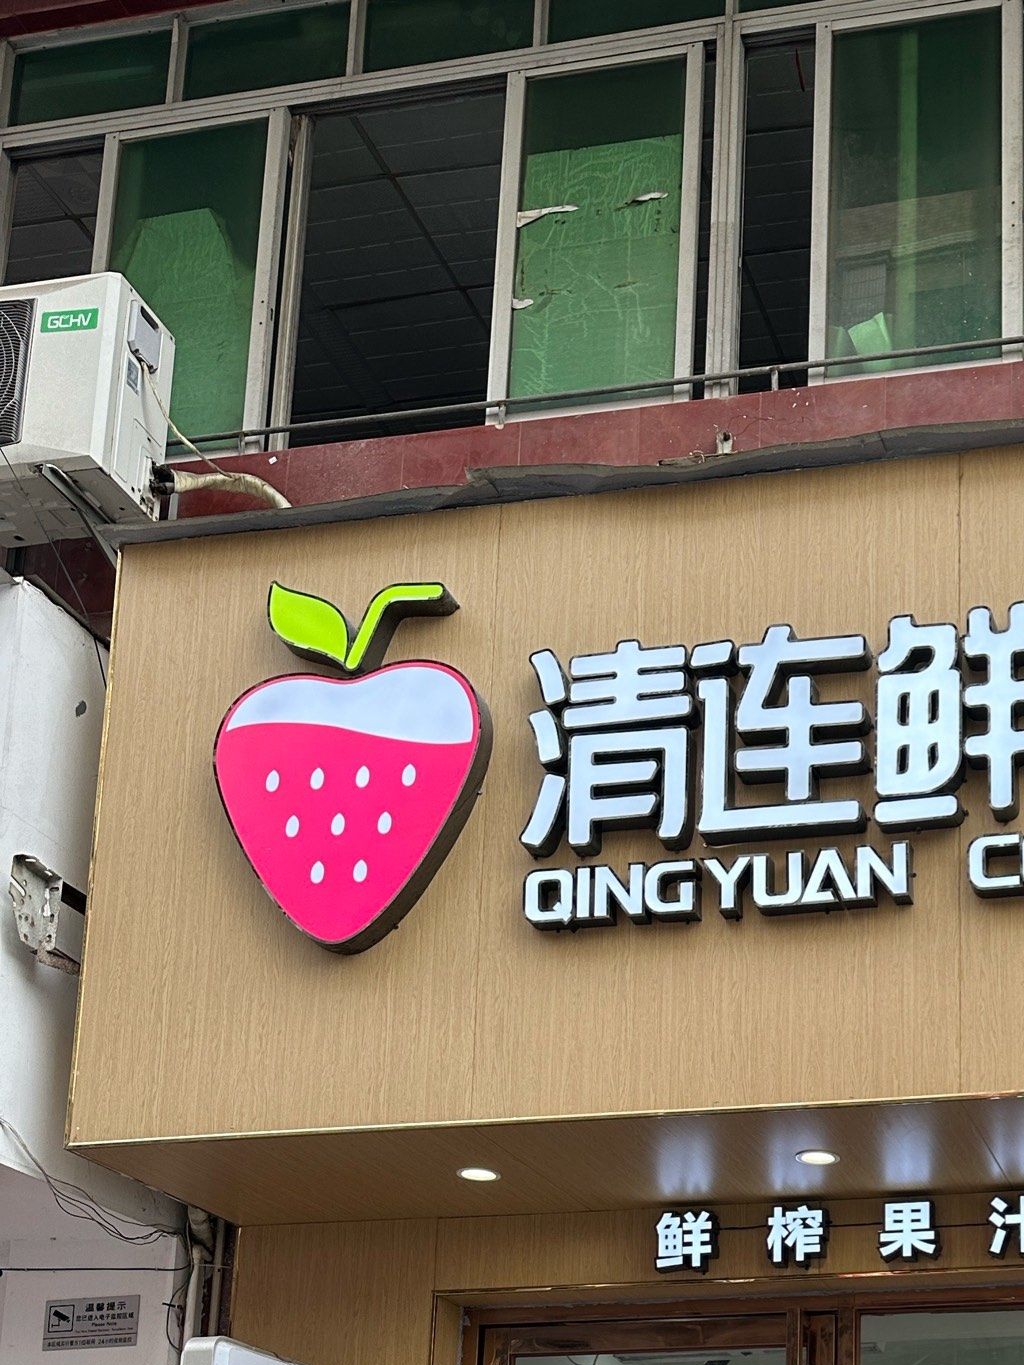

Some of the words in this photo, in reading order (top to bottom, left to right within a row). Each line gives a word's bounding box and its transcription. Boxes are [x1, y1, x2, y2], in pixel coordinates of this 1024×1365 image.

[47, 313, 92, 329] GCHV
[522, 839, 913, 931] QINGYUAN
[85, 1302, 127, 1313] 温馨提示
